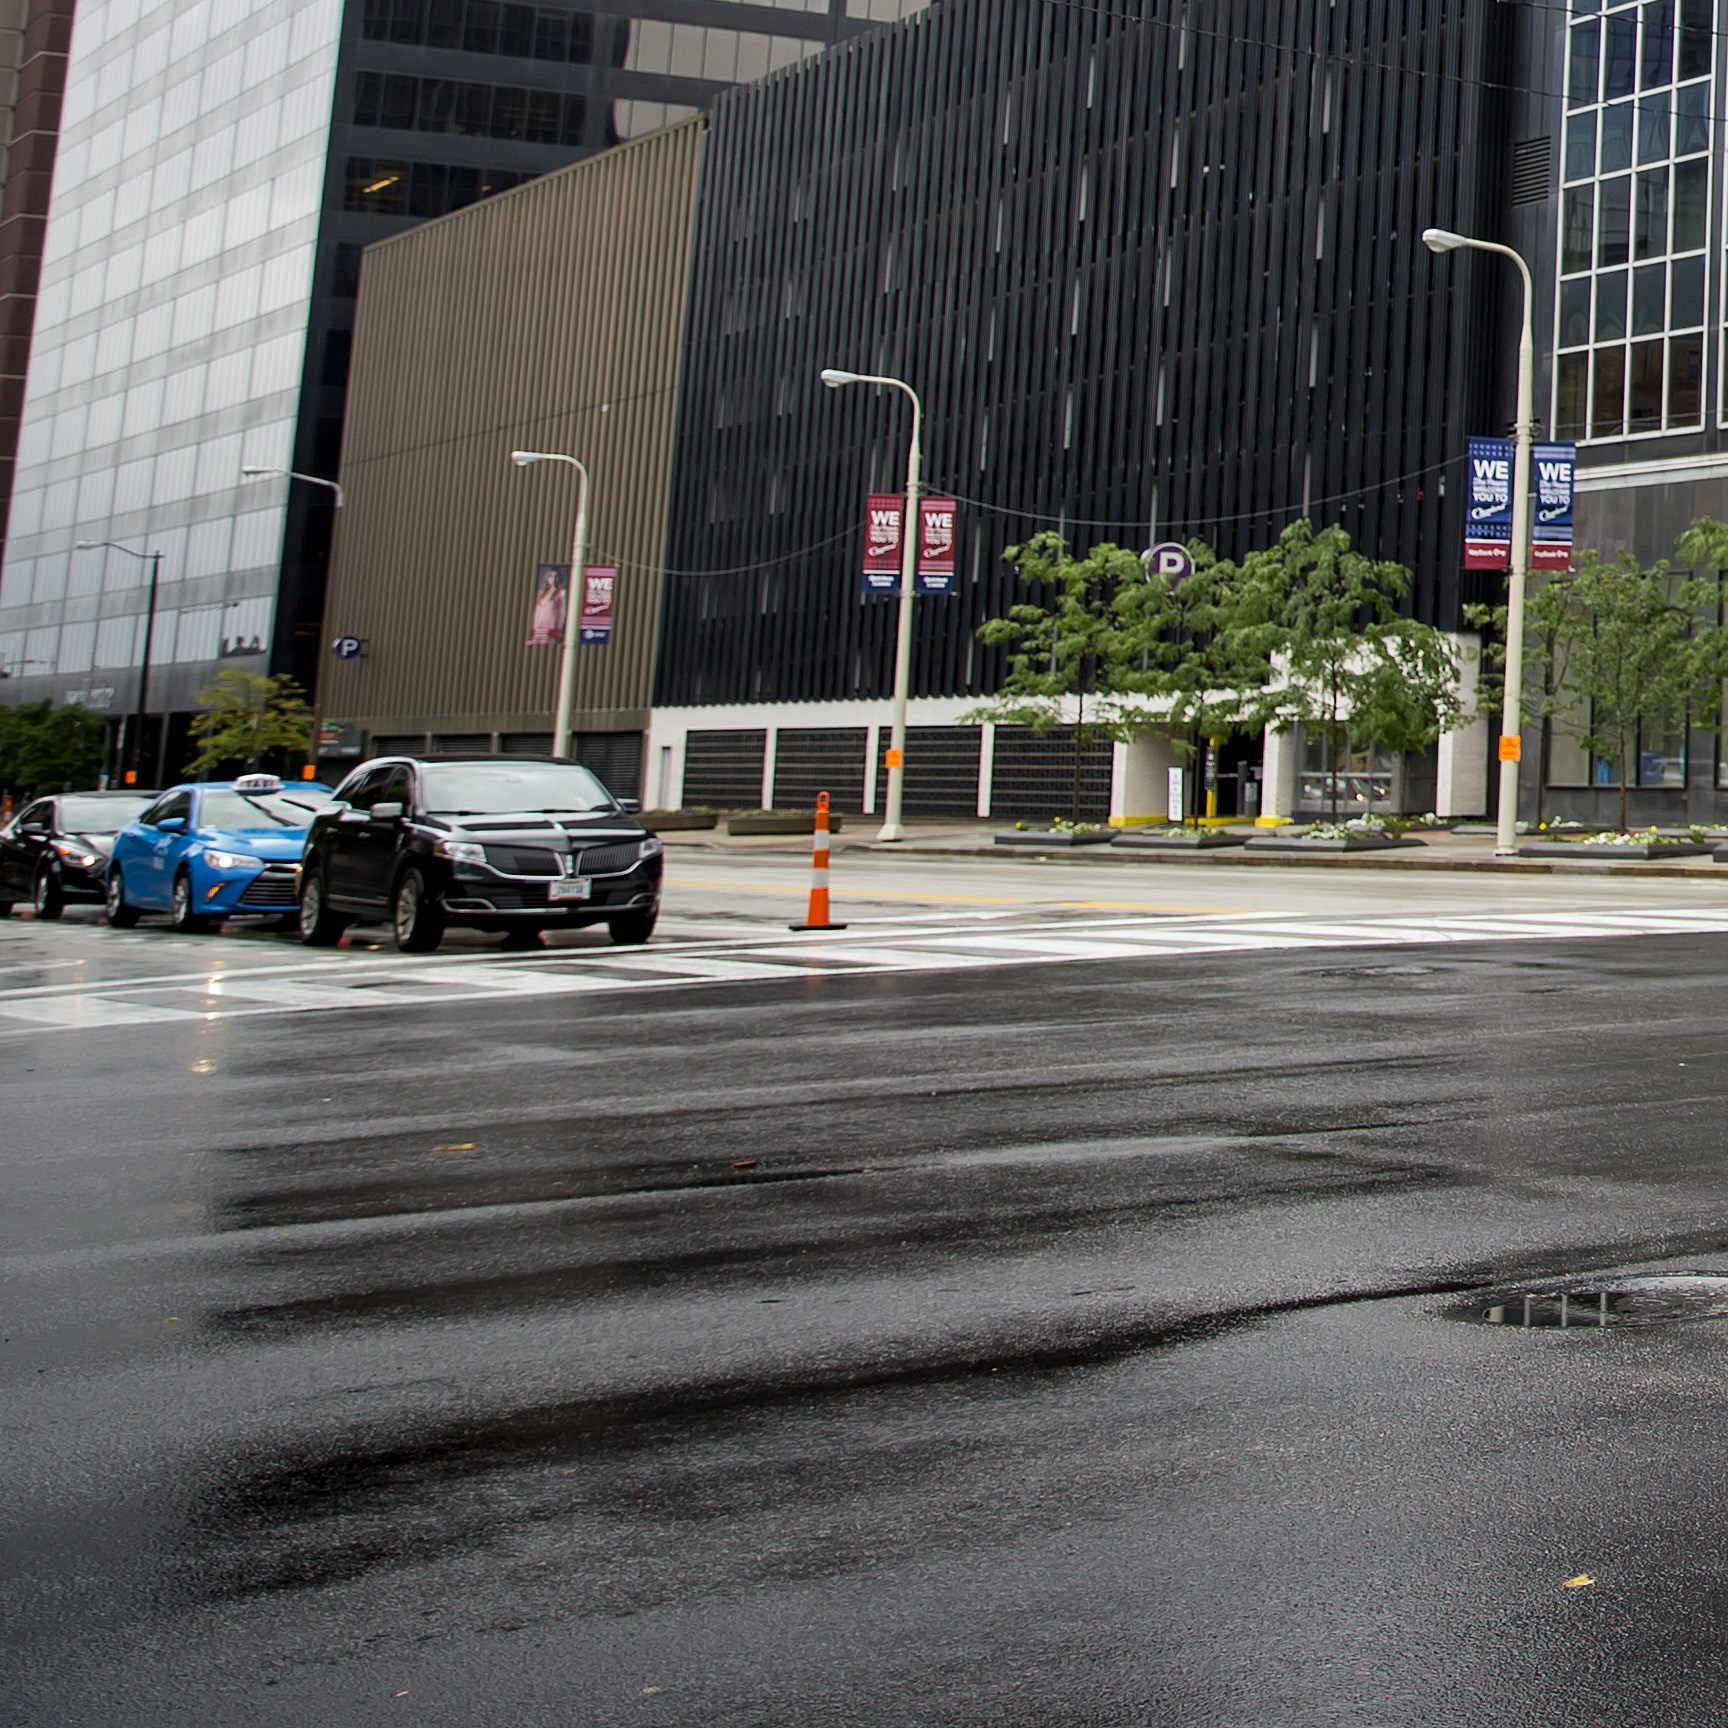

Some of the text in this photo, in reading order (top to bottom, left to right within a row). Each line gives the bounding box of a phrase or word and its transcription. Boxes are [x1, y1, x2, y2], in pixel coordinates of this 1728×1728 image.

[1473, 459, 1509, 479] WE
[1539, 462, 1571, 481] WE
[1473, 492, 1509, 503] YOU TO
[1540, 494, 1570, 505] YOU TO
[870, 510, 900, 526] WE
[925, 513, 953, 528] WE
[341, 639, 359, 657] P
